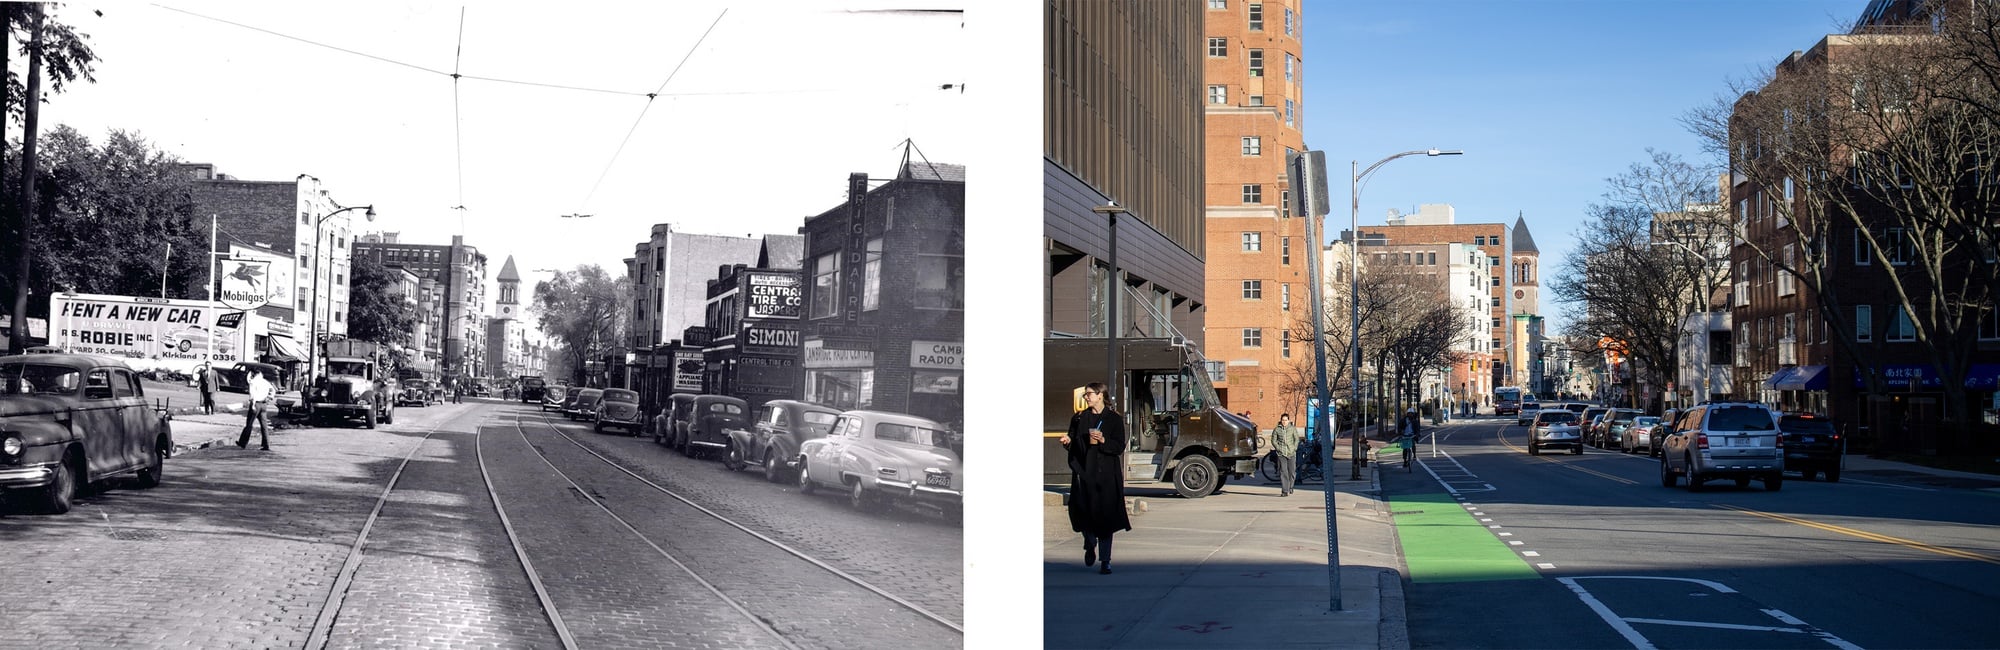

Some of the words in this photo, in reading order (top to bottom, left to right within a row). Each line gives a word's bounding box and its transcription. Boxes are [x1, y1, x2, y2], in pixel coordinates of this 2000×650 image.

[848, 179, 866, 321] FRIGIDAIRE
[223, 290, 265, 305] Mobilgas
[751, 294, 778, 305] TIRE
[107, 305, 119, 319] A
[125, 306, 163, 322] NEW
[167, 308, 202, 324] CAR
[81, 330, 134, 346] ROBIE
[136, 333, 154, 342] INC.
[919, 354, 955, 365] RADIO
